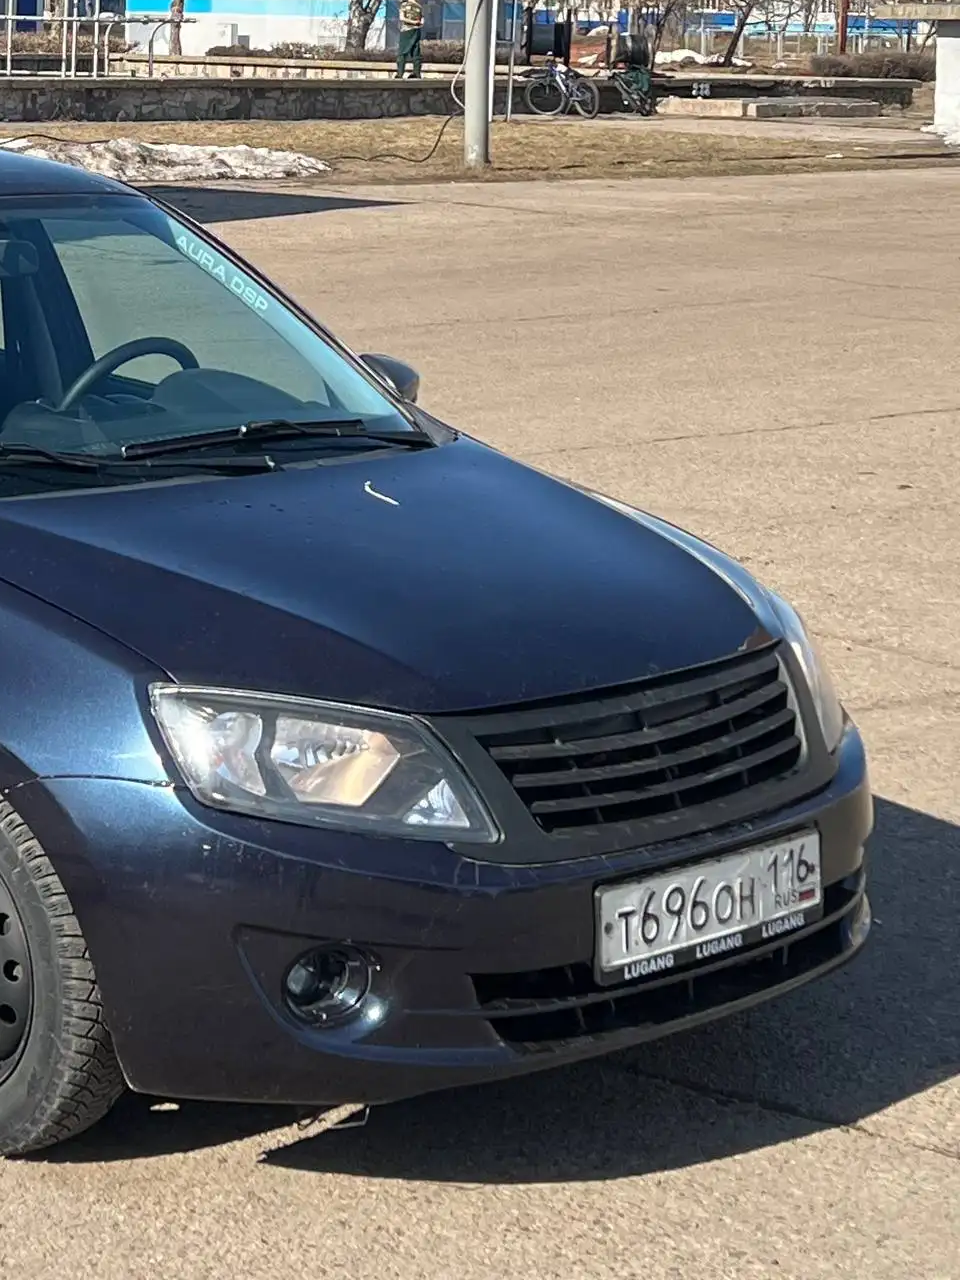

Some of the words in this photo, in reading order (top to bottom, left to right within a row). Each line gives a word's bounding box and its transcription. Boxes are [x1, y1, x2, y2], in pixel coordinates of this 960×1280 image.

[176, 235, 226, 283] AURA
[230, 275, 269, 312] DSP
[767, 843, 810, 893] 116
[774, 889, 798, 910] RUS
[624, 953, 674, 980] LUGANG
[696, 933, 743, 959] LUGANG
[761, 913, 805, 938] LUGANG
